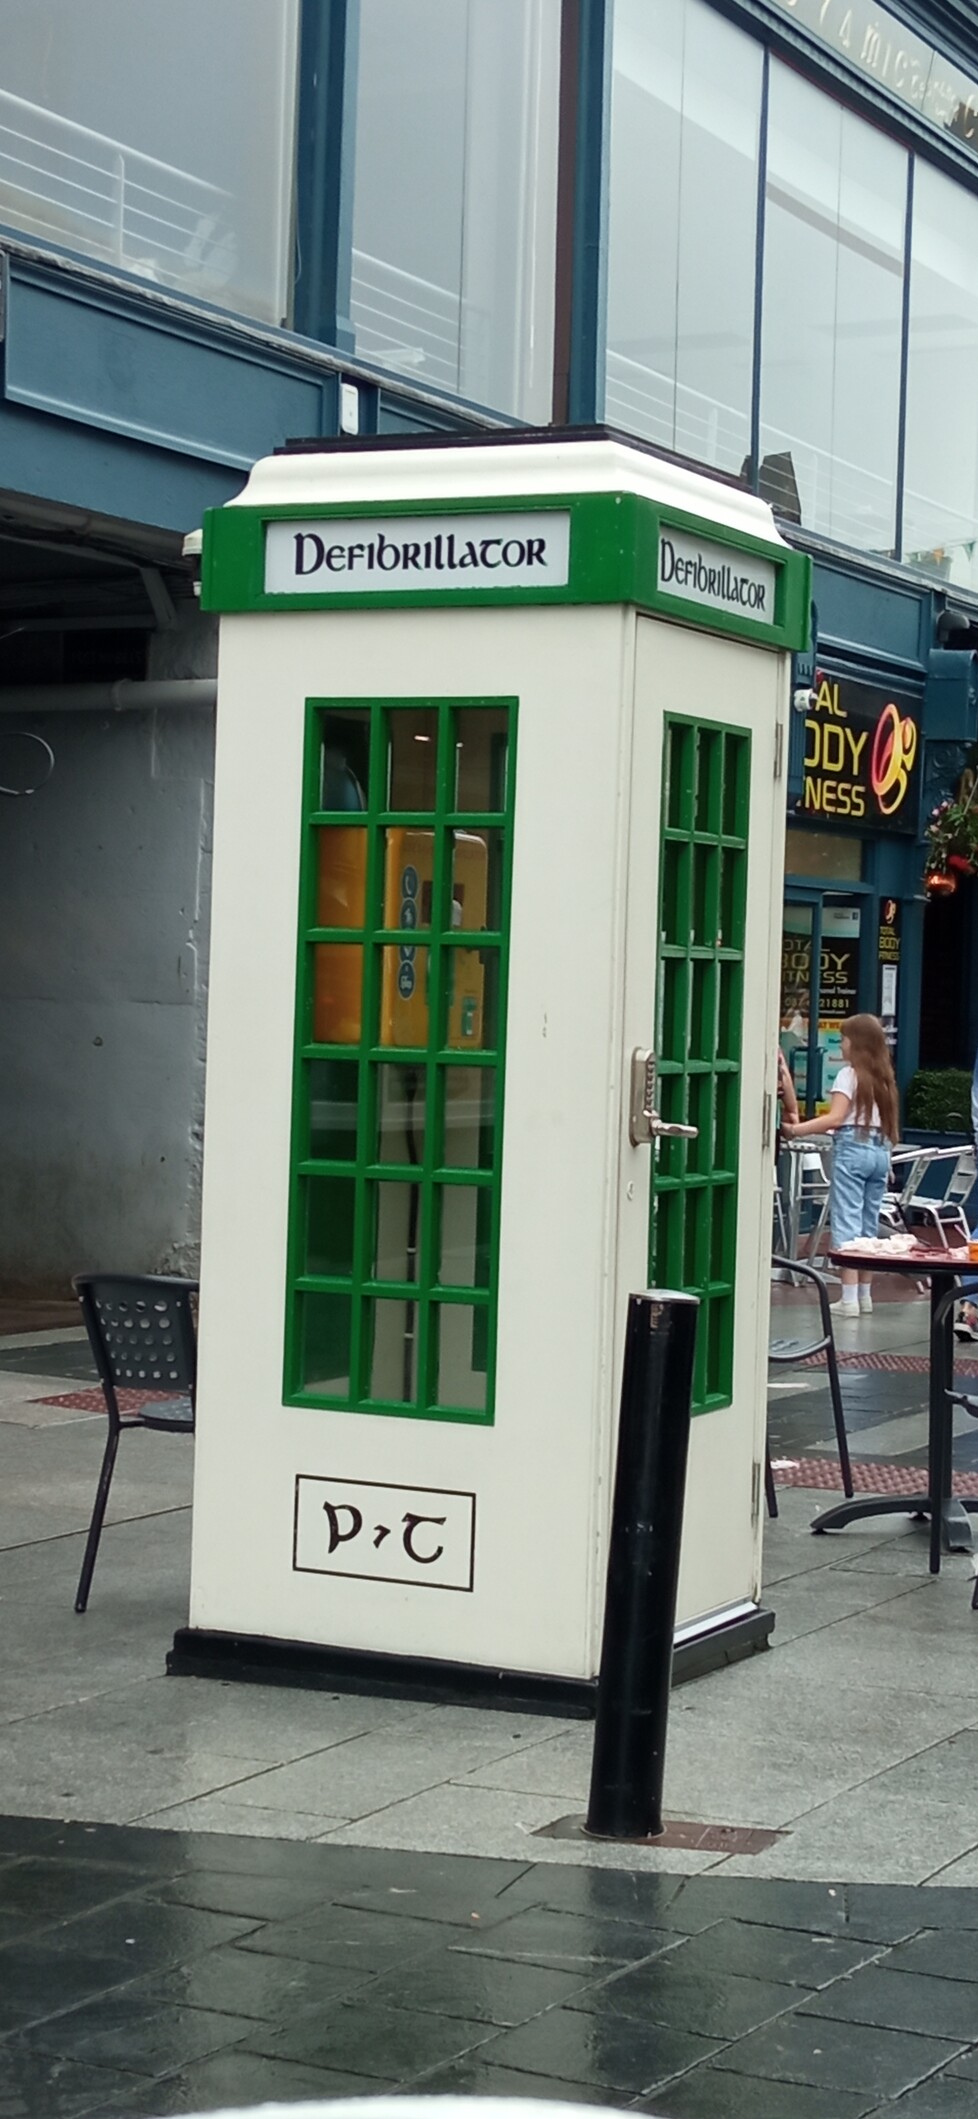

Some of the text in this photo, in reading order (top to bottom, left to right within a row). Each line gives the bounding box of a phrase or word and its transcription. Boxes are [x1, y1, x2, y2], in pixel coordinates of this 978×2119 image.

[804, 719, 869, 776] ODY
[804, 776, 866, 817] NESS
[879, 936, 901, 950] BODY
